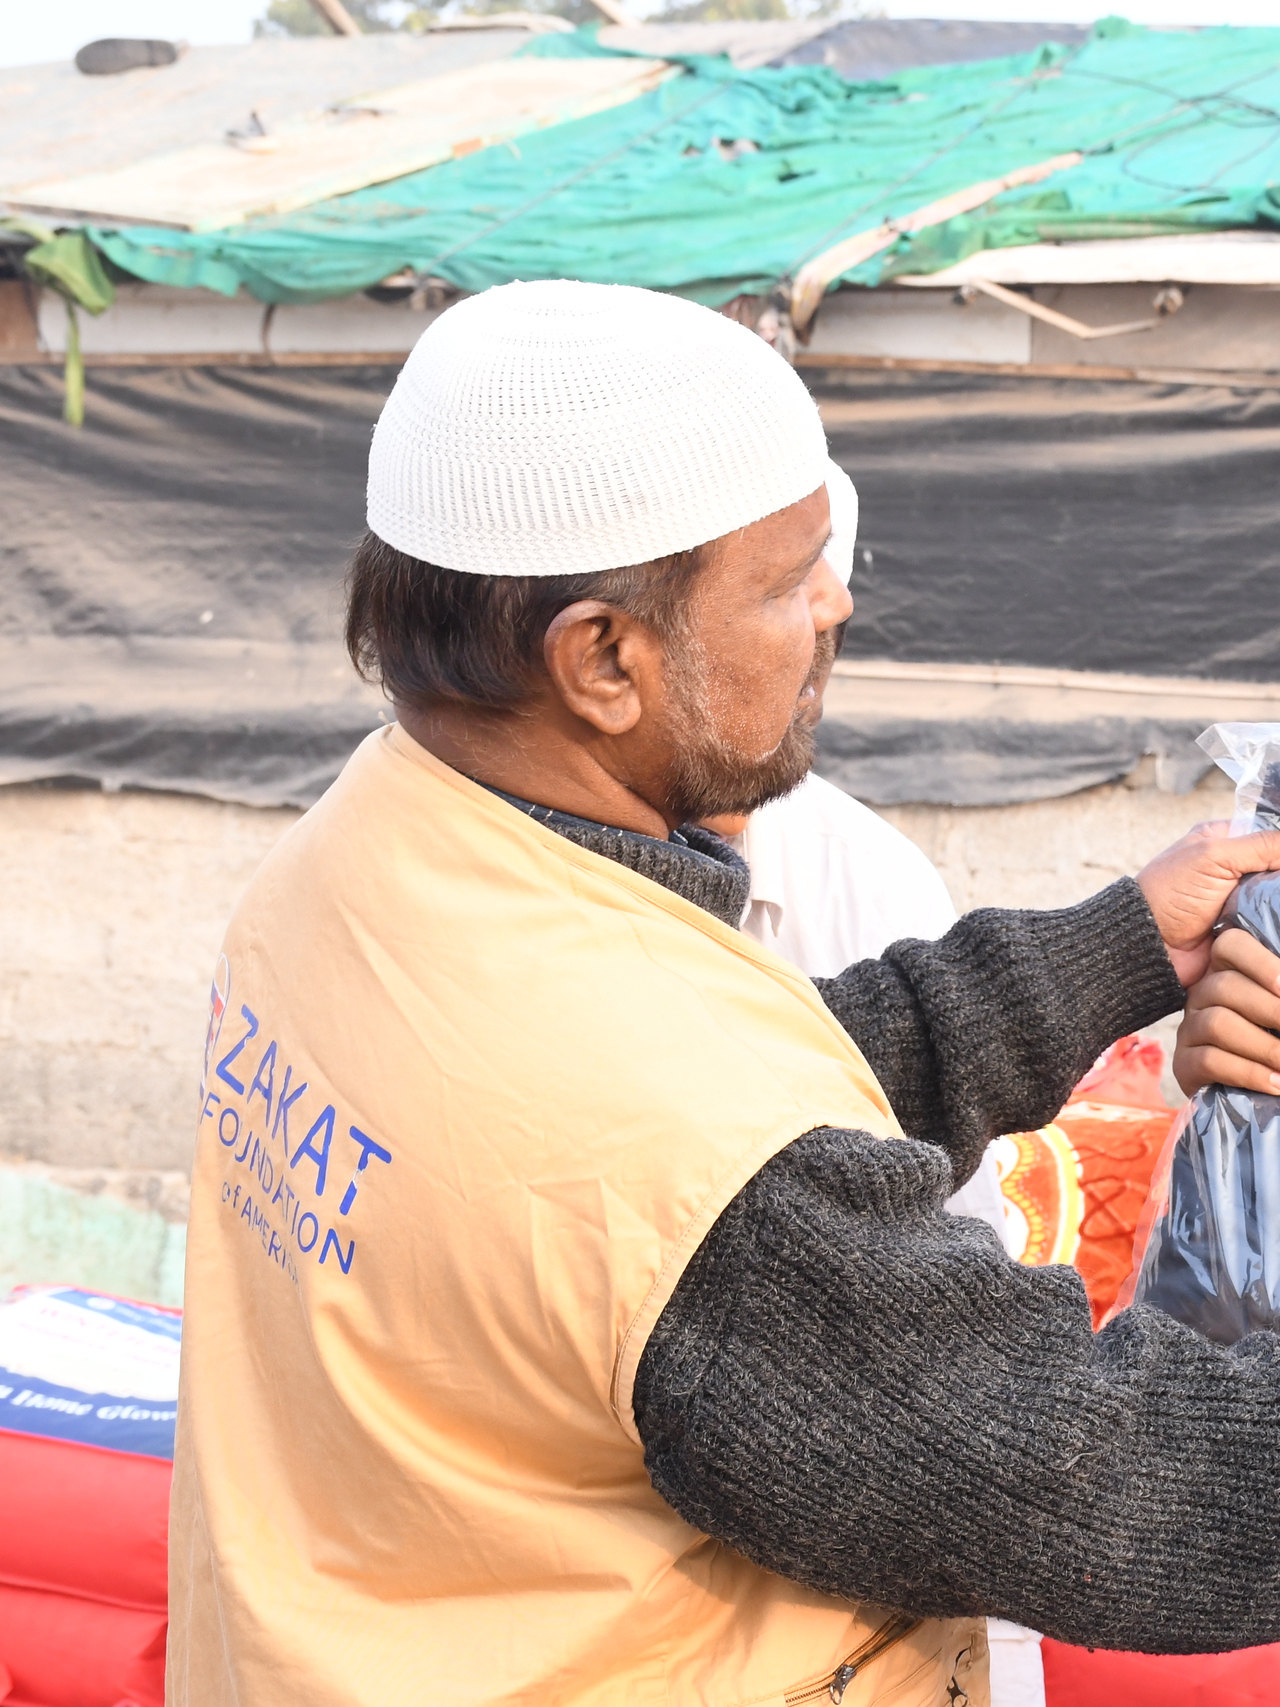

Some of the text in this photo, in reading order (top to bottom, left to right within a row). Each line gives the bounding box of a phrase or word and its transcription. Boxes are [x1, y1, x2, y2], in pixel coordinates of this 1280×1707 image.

[200, 1091, 356, 1276] FOUNDATION
[216, 1003, 392, 1217] ZAKAT
[221, 1181, 242, 1209] of
